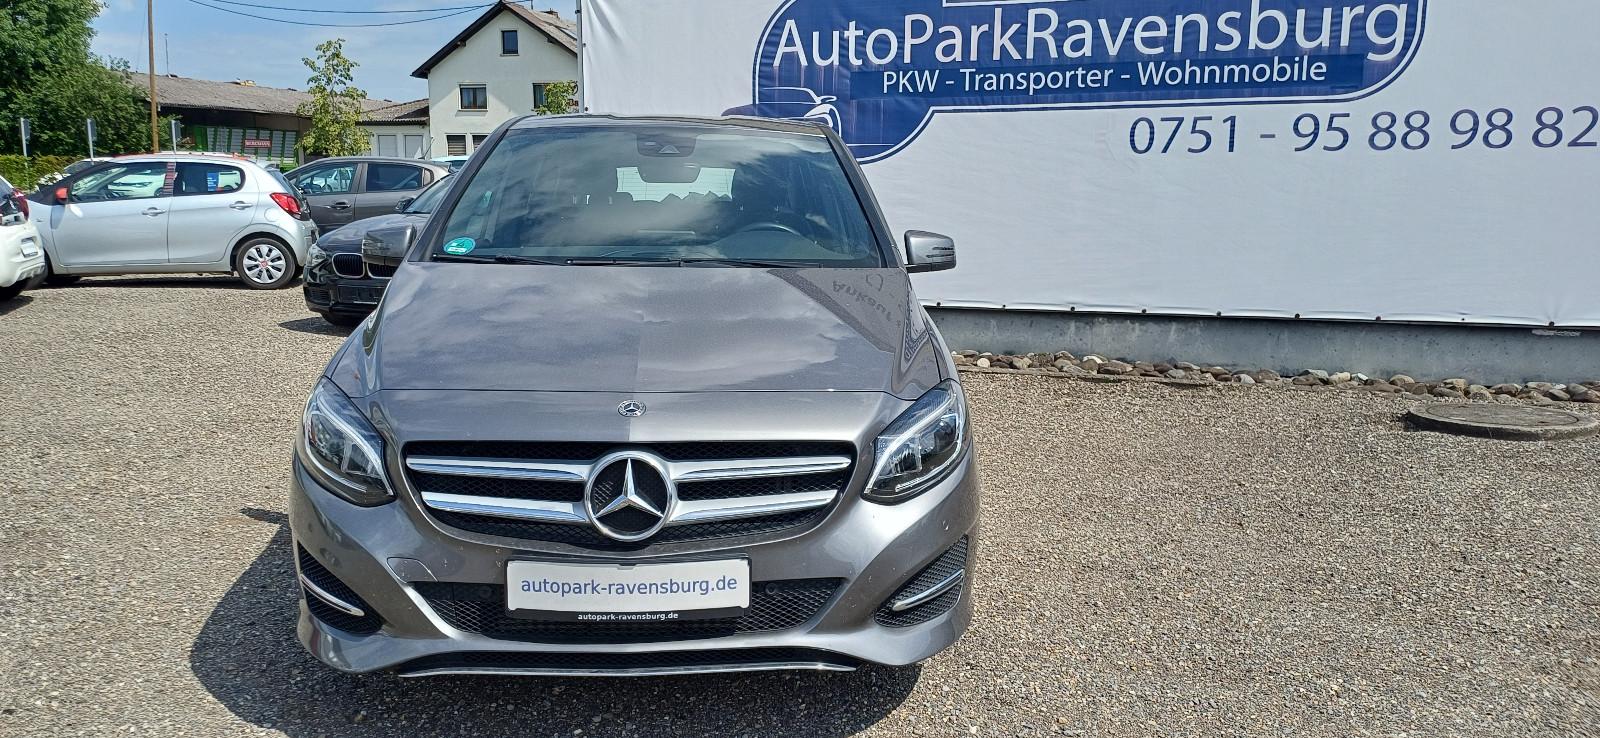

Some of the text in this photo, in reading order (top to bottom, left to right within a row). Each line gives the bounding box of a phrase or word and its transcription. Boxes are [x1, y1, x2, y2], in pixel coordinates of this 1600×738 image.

[773, 0, 1408, 68] AutoParkRavensburg
[883, 70, 940, 94] PKW
[960, 67, 1114, 96] Transporter
[1137, 55, 1328, 86] Wohnmobile
[1129, 115, 1238, 155] 0751
[1292, 112, 1351, 153] 95
[1367, 110, 1431, 151] 88
[1449, 107, 1514, 150] 98
[1531, 105, 1599, 149] 82
[520, 575, 738, 597] autopark-ravensburg.de
[577, 611, 679, 621] autopark-ravensburg.de
